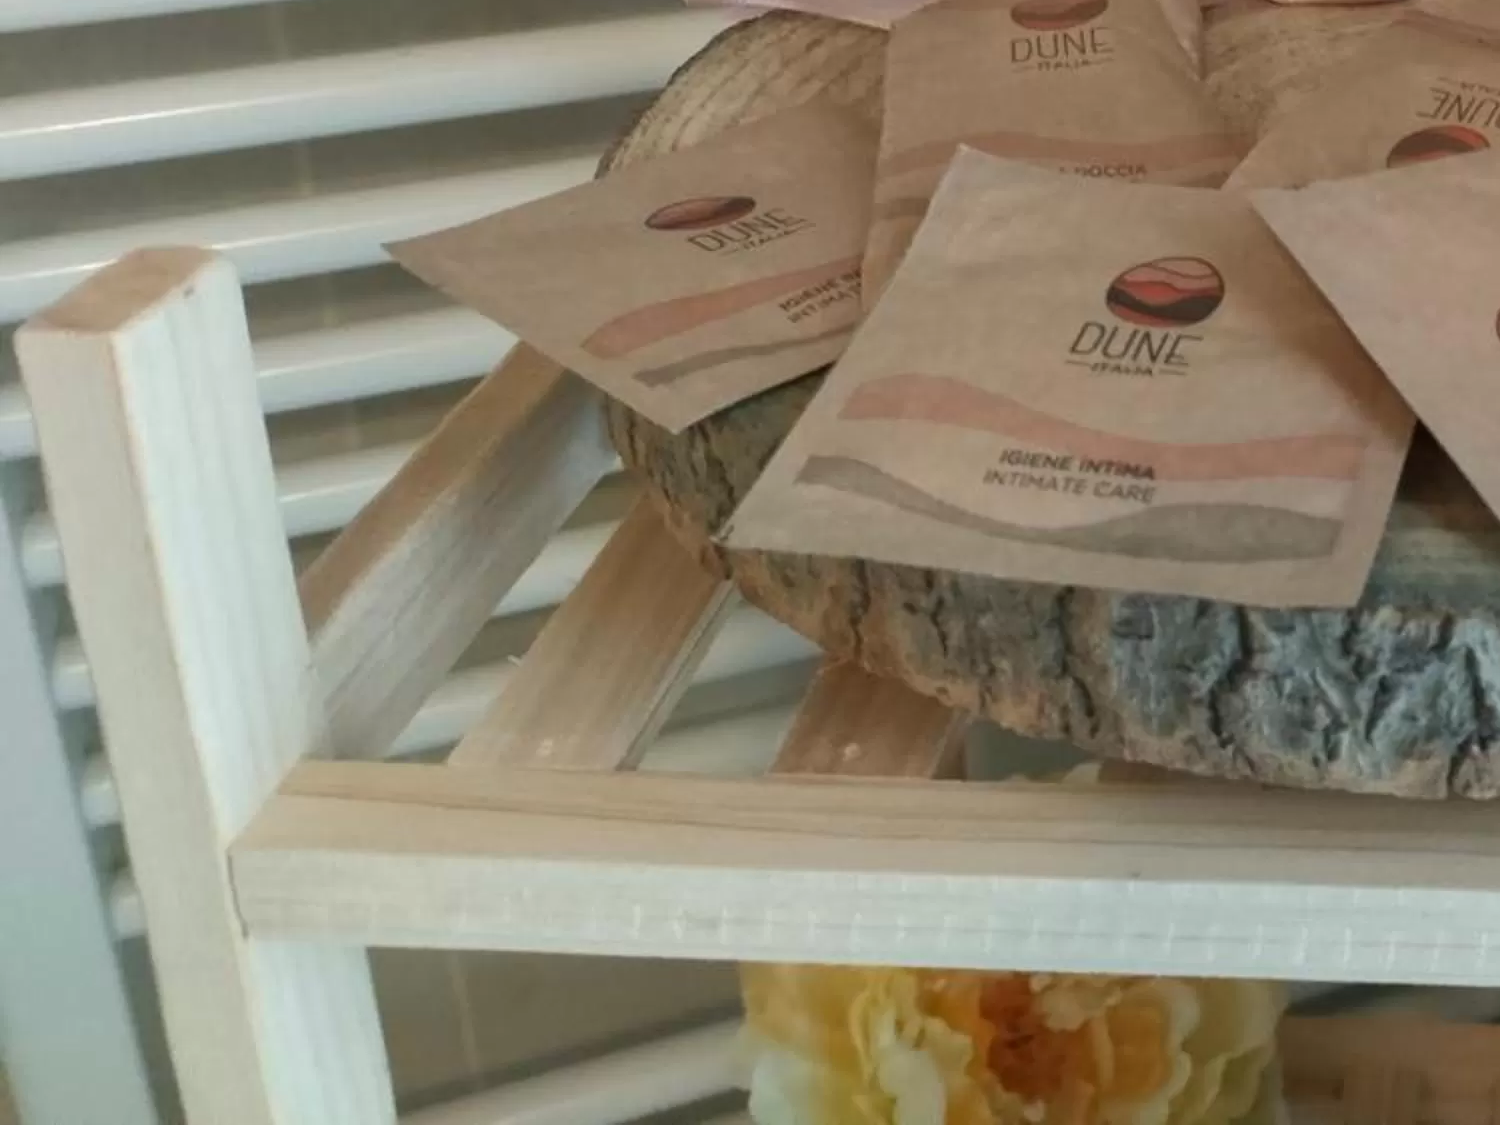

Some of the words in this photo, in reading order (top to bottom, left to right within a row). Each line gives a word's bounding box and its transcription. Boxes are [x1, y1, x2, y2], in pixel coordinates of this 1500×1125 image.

[1010, 27, 1115, 63] DUNE
[1037, 59, 1090, 72] ITALIA
[686, 207, 808, 252] DUNE
[1068, 321, 1204, 366] DUNE
[1089, 362, 1153, 376] ITALIA
[999, 448, 1073, 471] IGIENE
[1079, 455, 1156, 480] INTIMA
[982, 468, 1089, 496] INTIMATE
[1092, 479, 1157, 505] CARE
